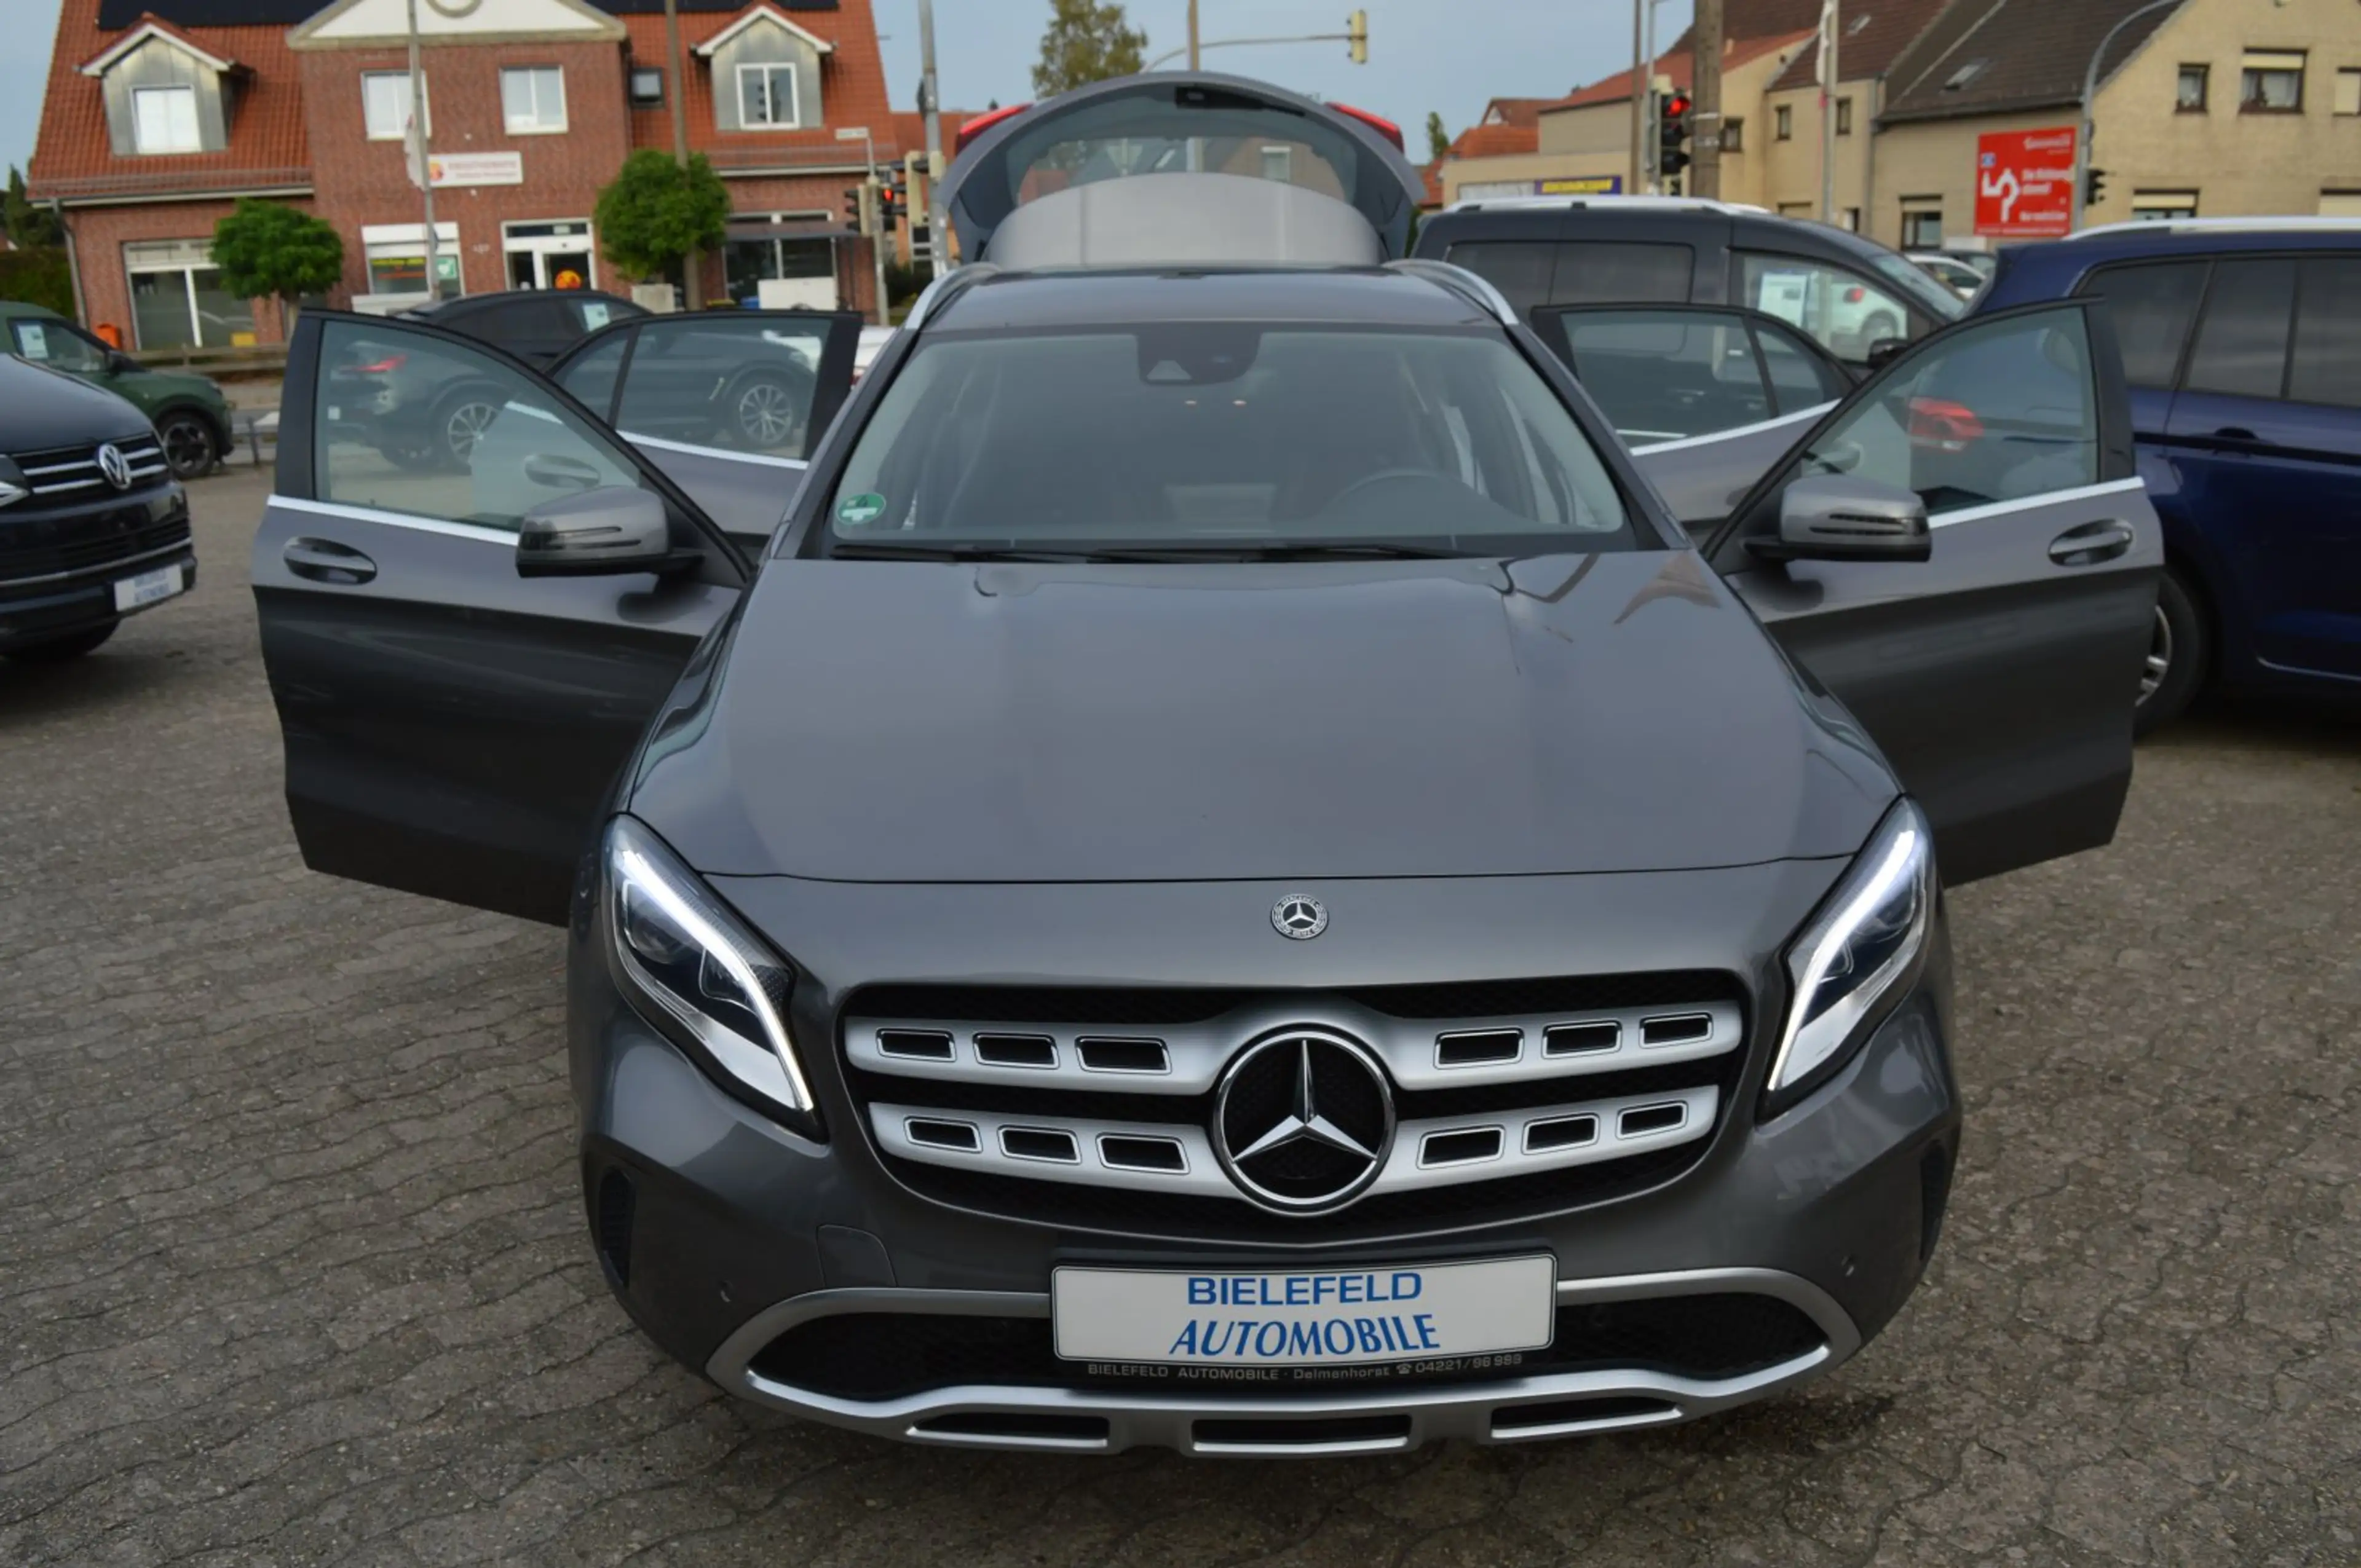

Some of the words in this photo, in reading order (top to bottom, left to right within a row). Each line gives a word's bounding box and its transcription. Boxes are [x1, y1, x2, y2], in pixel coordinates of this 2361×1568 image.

[1188, 1272, 1422, 1305] BIELEFELD
[1169, 1314, 1440, 1357] AUTOMOBILE
[1088, 1364, 1168, 1377] BIELEFELD
[1177, 1367, 1279, 1381] AUTOMOBILE
[1293, 1367, 1390, 1380] Delmenhorst
